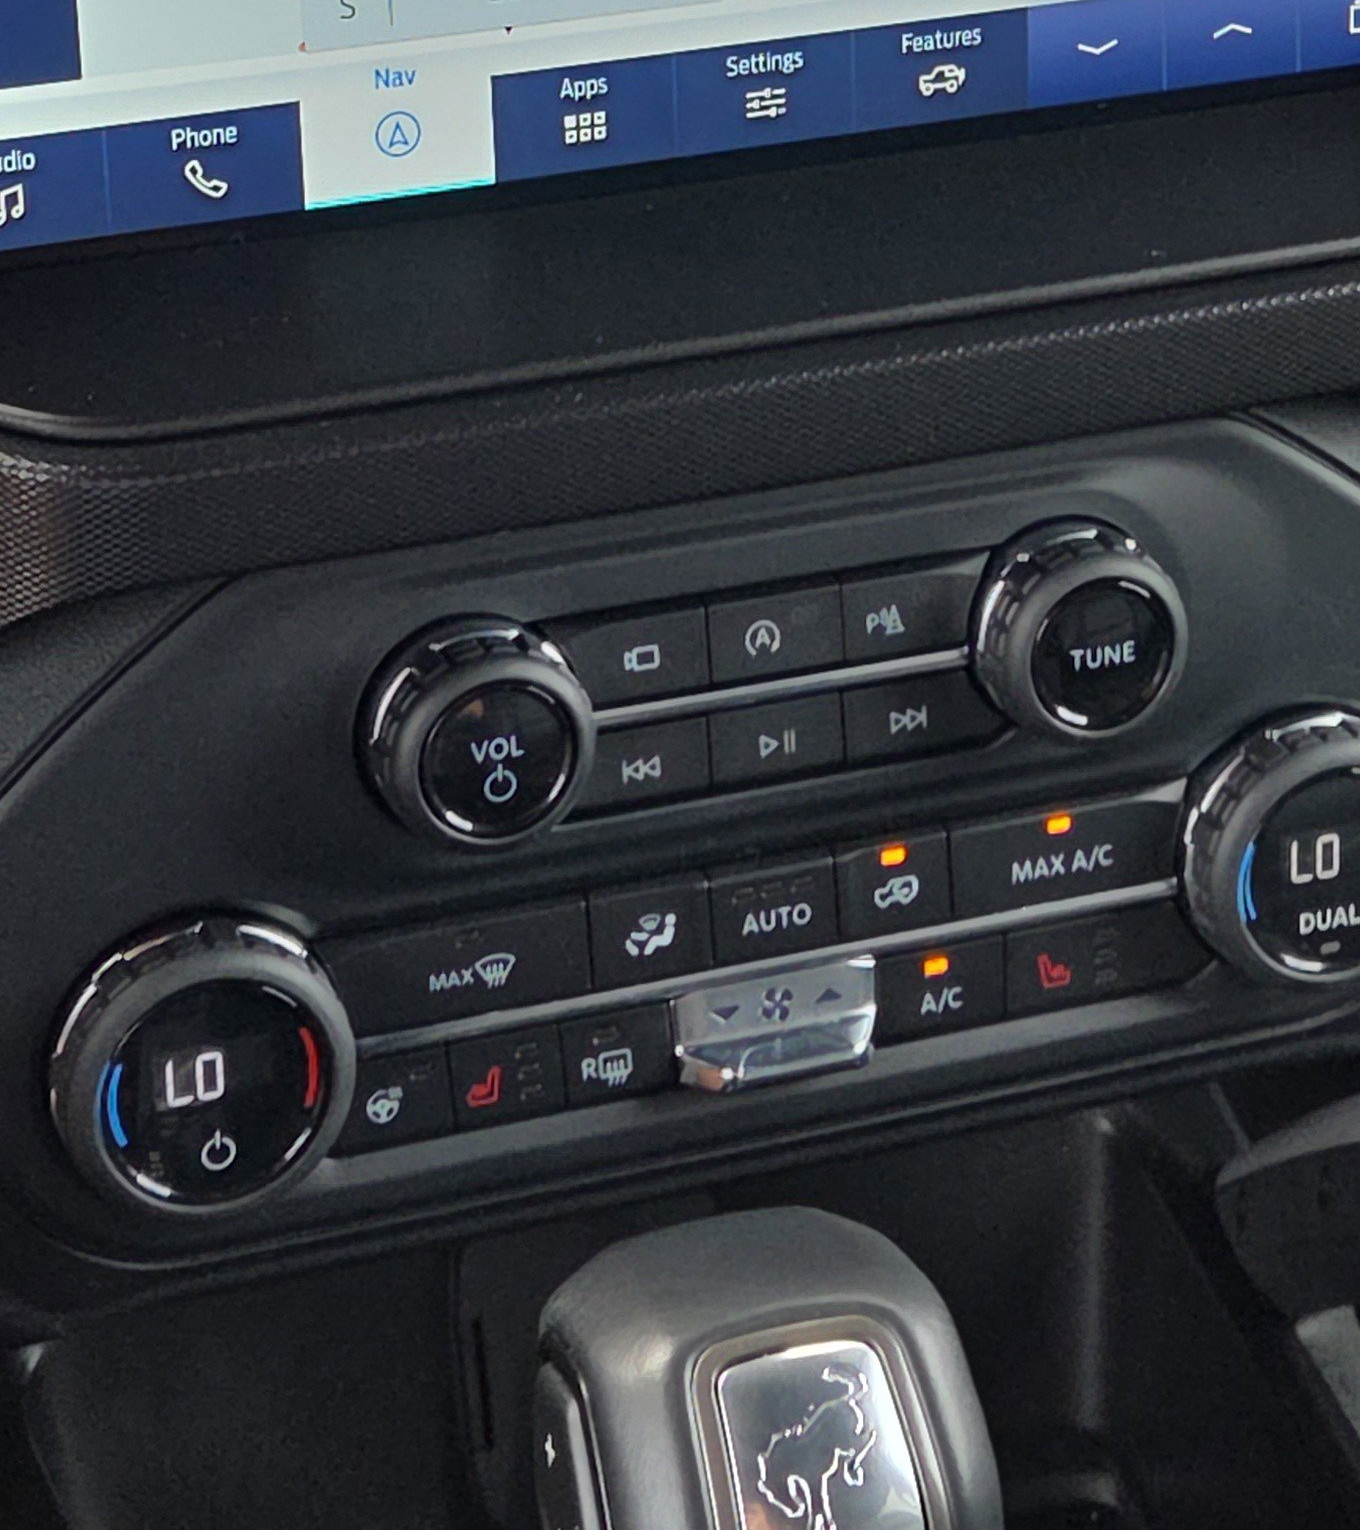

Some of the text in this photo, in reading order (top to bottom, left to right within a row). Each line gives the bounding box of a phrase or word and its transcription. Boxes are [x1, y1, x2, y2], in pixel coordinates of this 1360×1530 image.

[901, 27, 982, 55] Features
[725, 50, 805, 78] Settings
[374, 67, 416, 90] Nav
[559, 76, 609, 102] Apps
[170, 124, 239, 152] Phone
[1069, 640, 1136, 671] TUNE
[470, 735, 525, 764] VOL
[1011, 843, 1114, 884] MAX A/C
[1290, 832, 1340, 885] LO
[742, 902, 812, 936] AUTO
[429, 967, 474, 992] MAX
[920, 986, 963, 1015] A/C
[164, 1050, 226, 1109] LO
[581, 1057, 597, 1081] R
